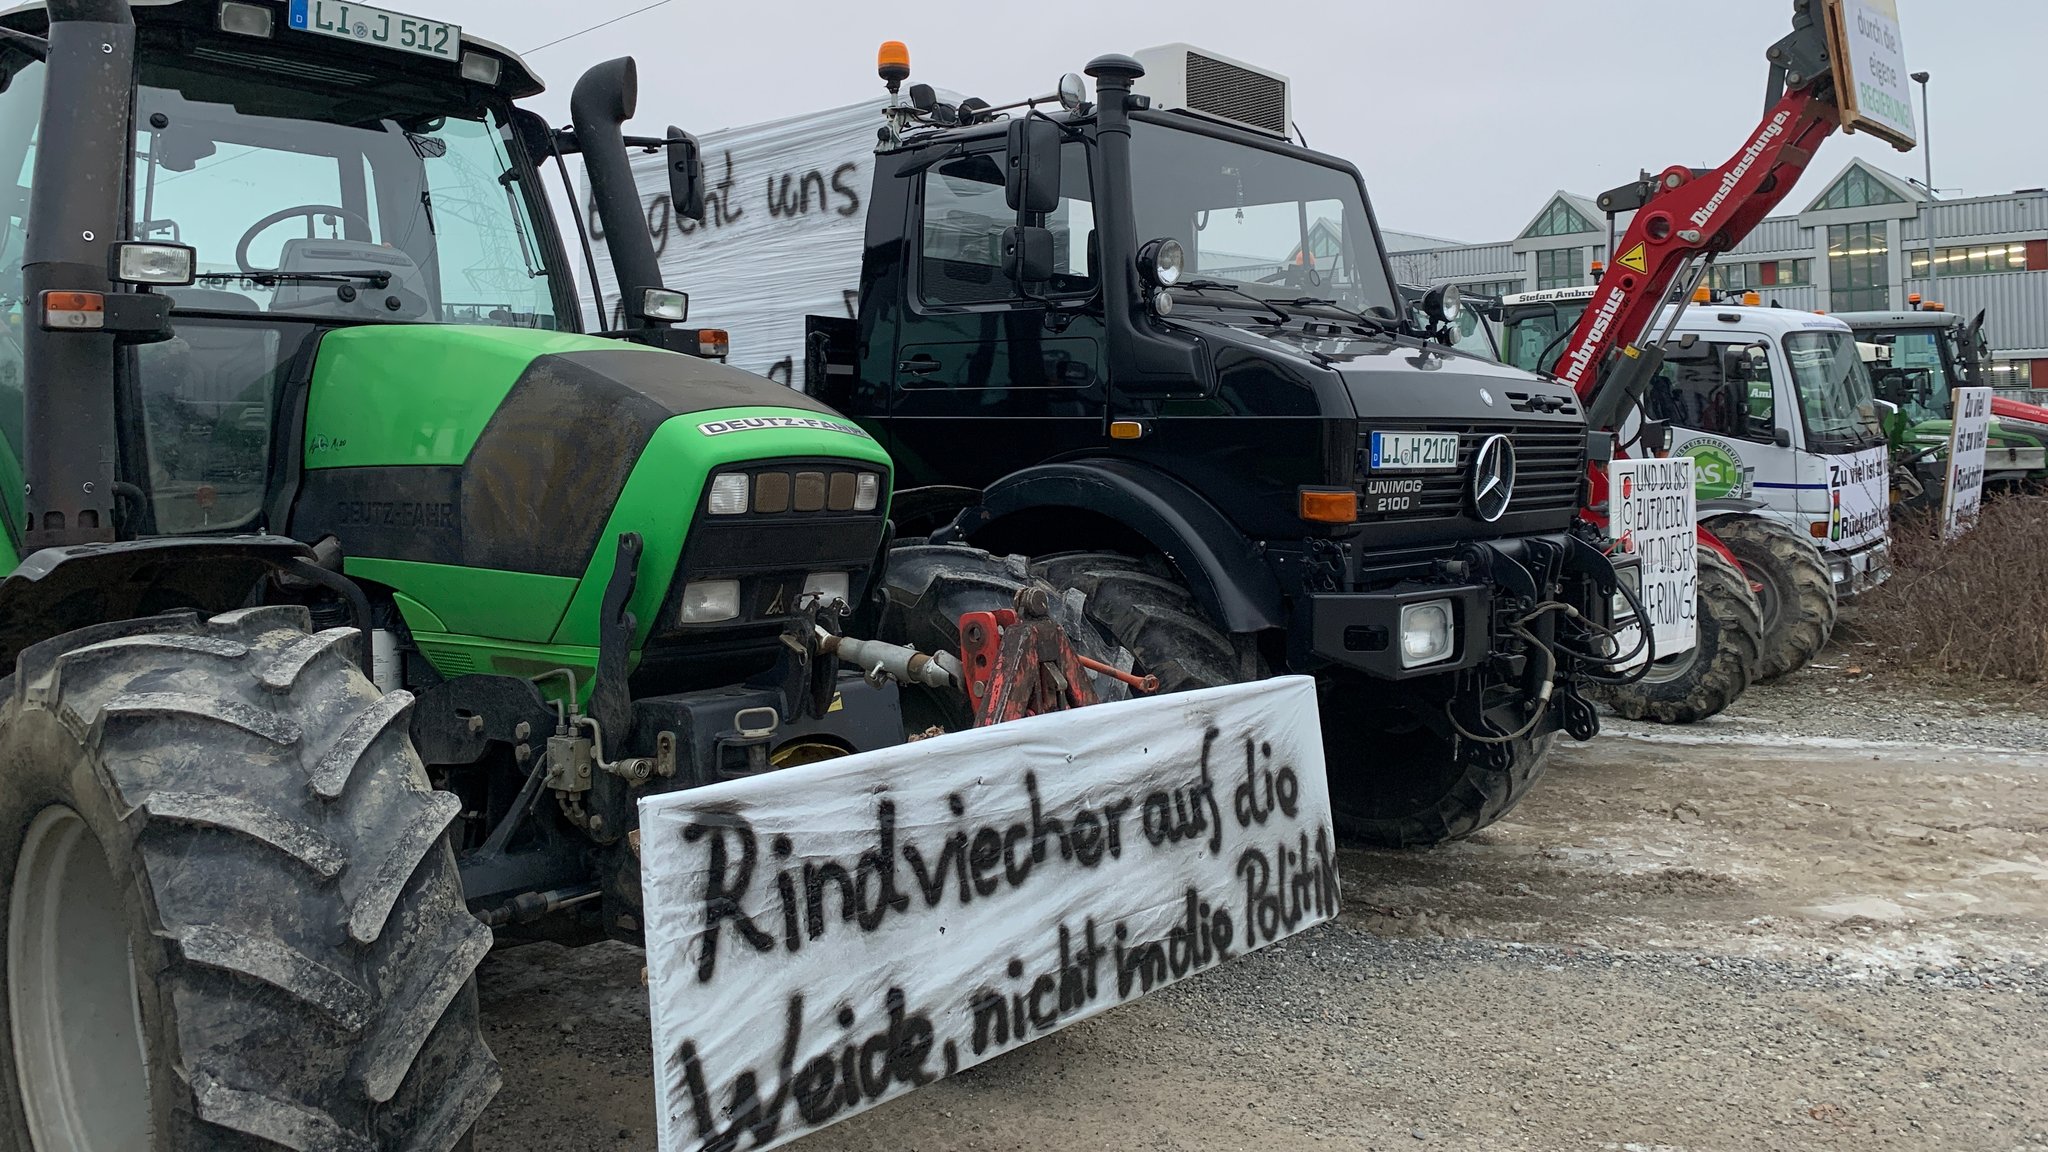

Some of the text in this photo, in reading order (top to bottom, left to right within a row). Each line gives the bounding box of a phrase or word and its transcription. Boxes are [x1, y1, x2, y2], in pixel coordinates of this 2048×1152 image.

[315, 1, 449, 55] LI J 512
[1857, 8, 1897, 55] durch die
[1869, 51, 1897, 88] eigene
[1690, 110, 1791, 228] Dienstleistunge
[766, 162, 860, 219] uns
[1519, 289, 1596, 303] Stefan Ambro
[704, 417, 869, 436] DEUTZ-FAHR
[1381, 437, 1457, 463] LI H 2100
[1676, 438, 1744, 470] USMEISTERSERVICE
[1368, 480, 1423, 494] UNIMOG
[1636, 461, 1690, 492] UND DU BIST
[1830, 465, 1848, 488] Zu
[1849, 459, 1866, 484] viel
[1378, 497, 1410, 511] 2100
[1636, 495, 1690, 531] ZUFRIEDEN
[1638, 531, 1698, 575] MIT DIESER
[1642, 575, 1697, 630] IERUNG?
[683, 771, 1133, 982] Rindviecher
[1236, 738, 1299, 828] die
[970, 917, 1107, 1056] nicht
